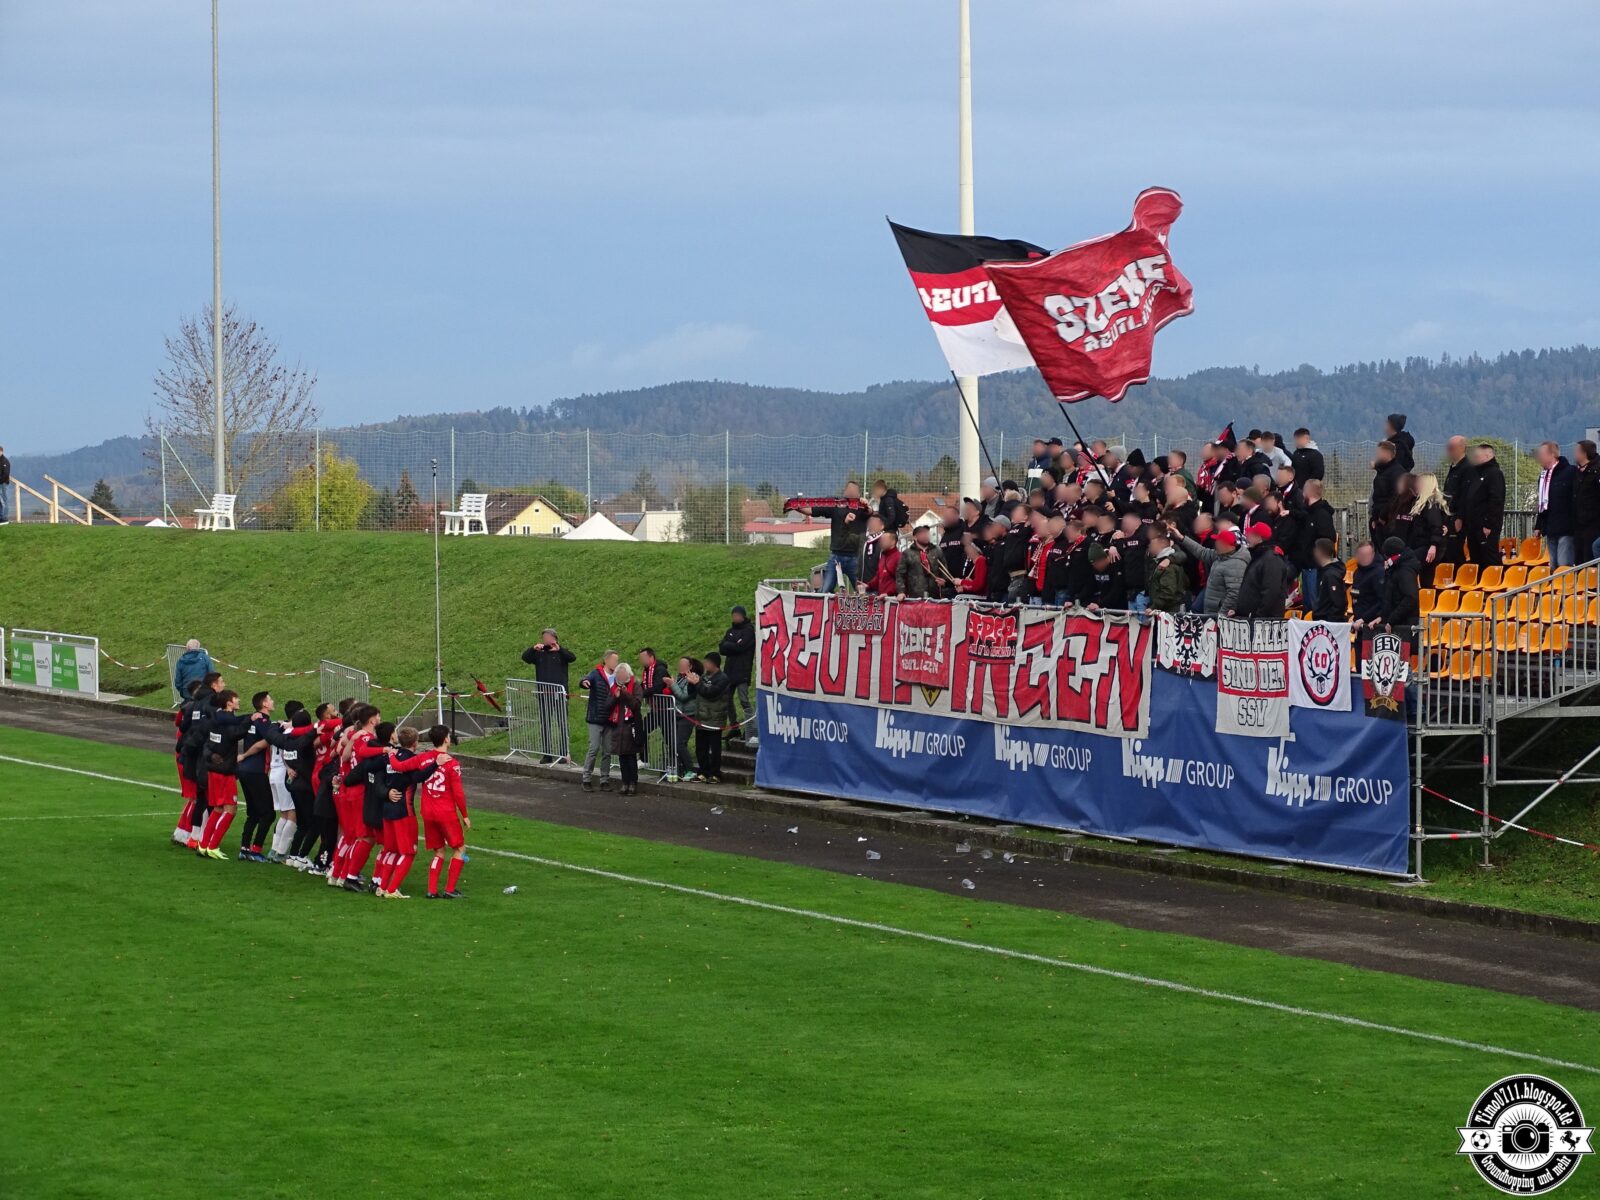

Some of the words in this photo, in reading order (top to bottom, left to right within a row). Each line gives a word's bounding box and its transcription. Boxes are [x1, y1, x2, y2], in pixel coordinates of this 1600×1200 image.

[1044, 254, 1168, 343] SZENE
[1219, 618, 1251, 653] WIR
[1252, 620, 1289, 653] ALLE
[1376, 637, 1399, 652] SSV
[1222, 656, 1257, 691] SIND
[1257, 658, 1285, 691] DER
[1238, 697, 1268, 727] SSV
[812, 718, 848, 743] GROUP
[926, 733, 966, 757] GROUP
[1051, 744, 1092, 772] GROUP
[1186, 760, 1235, 790] GROUP
[1335, 776, 1393, 805] GROUP
